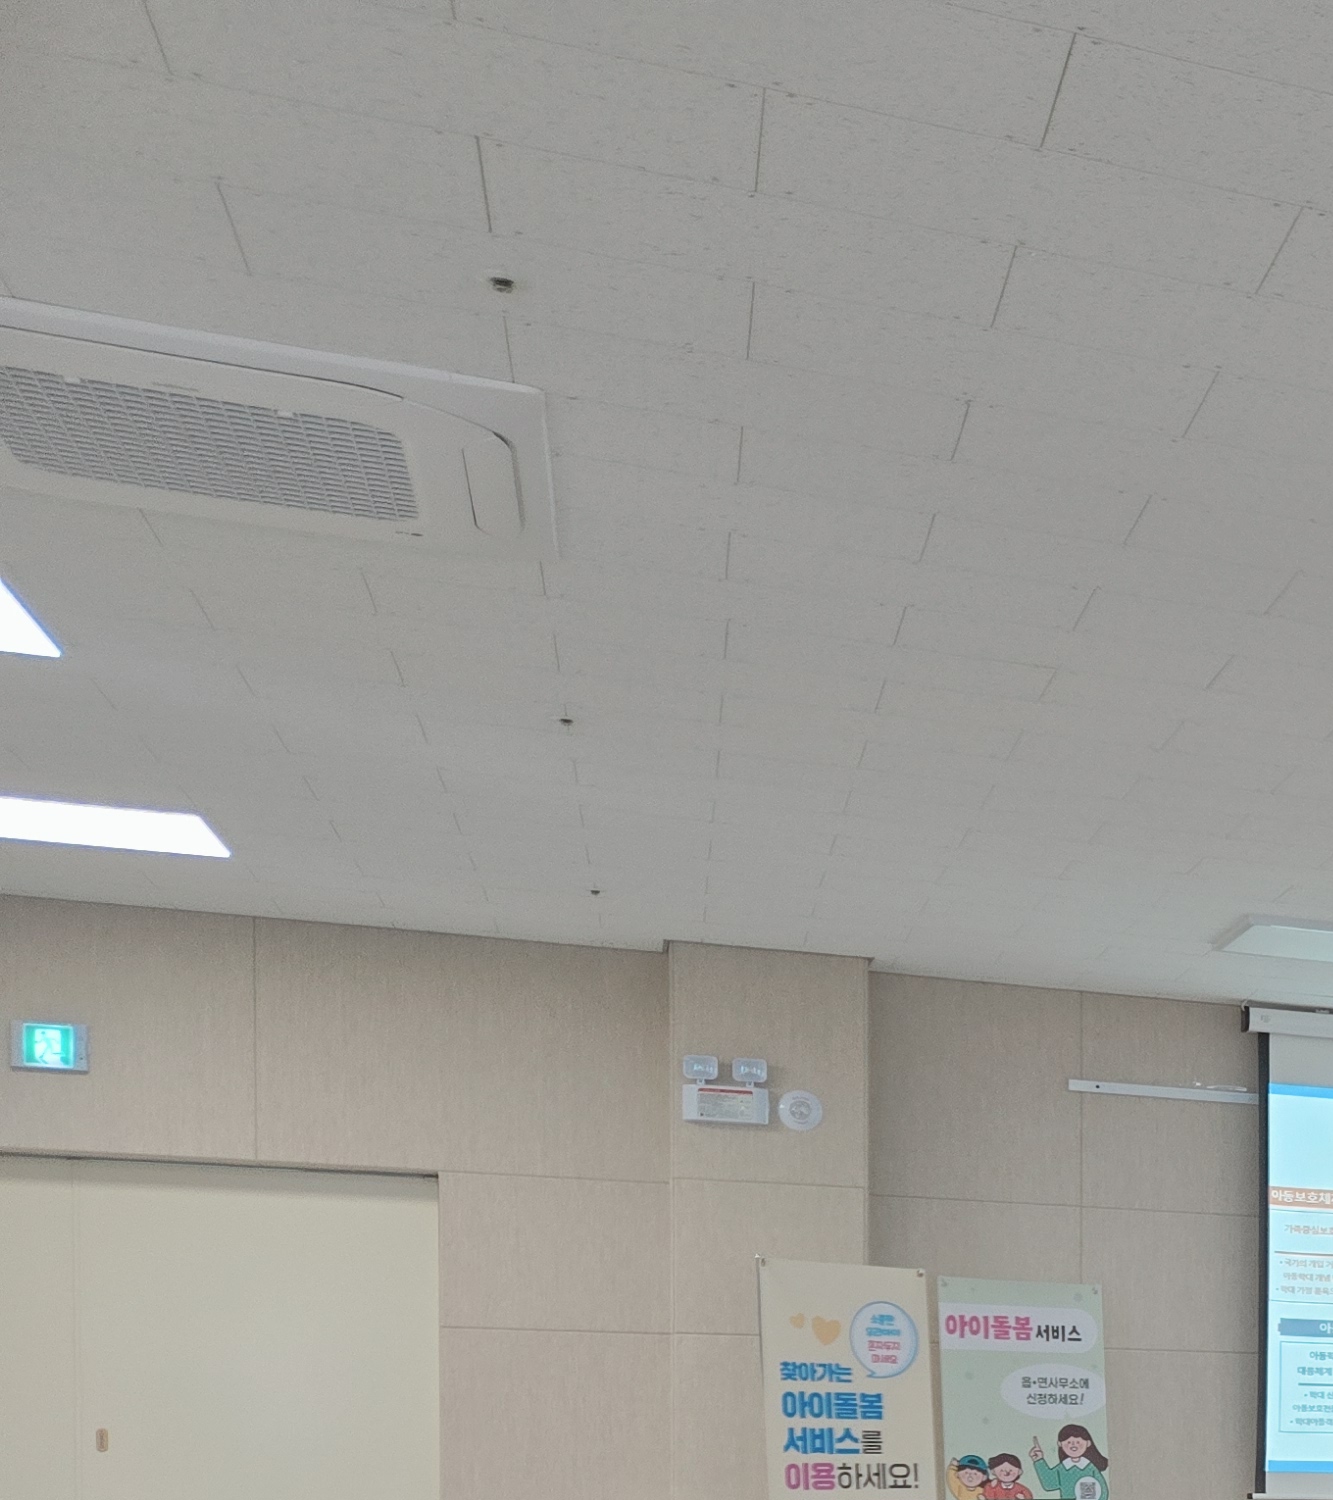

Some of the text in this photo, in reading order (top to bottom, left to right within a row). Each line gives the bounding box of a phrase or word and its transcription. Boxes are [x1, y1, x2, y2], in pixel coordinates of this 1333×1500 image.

[945, 1314, 1082, 1342] 아이돌봄 서비스
[780, 1361, 853, 1383] 찾아가는
[1297, 1366, 1333, 1376] 대응체계
[782, 1391, 884, 1420] 아이돌봄
[783, 1427, 884, 1455] 서비스를
[784, 1462, 919, 1491] 이용하세요!
